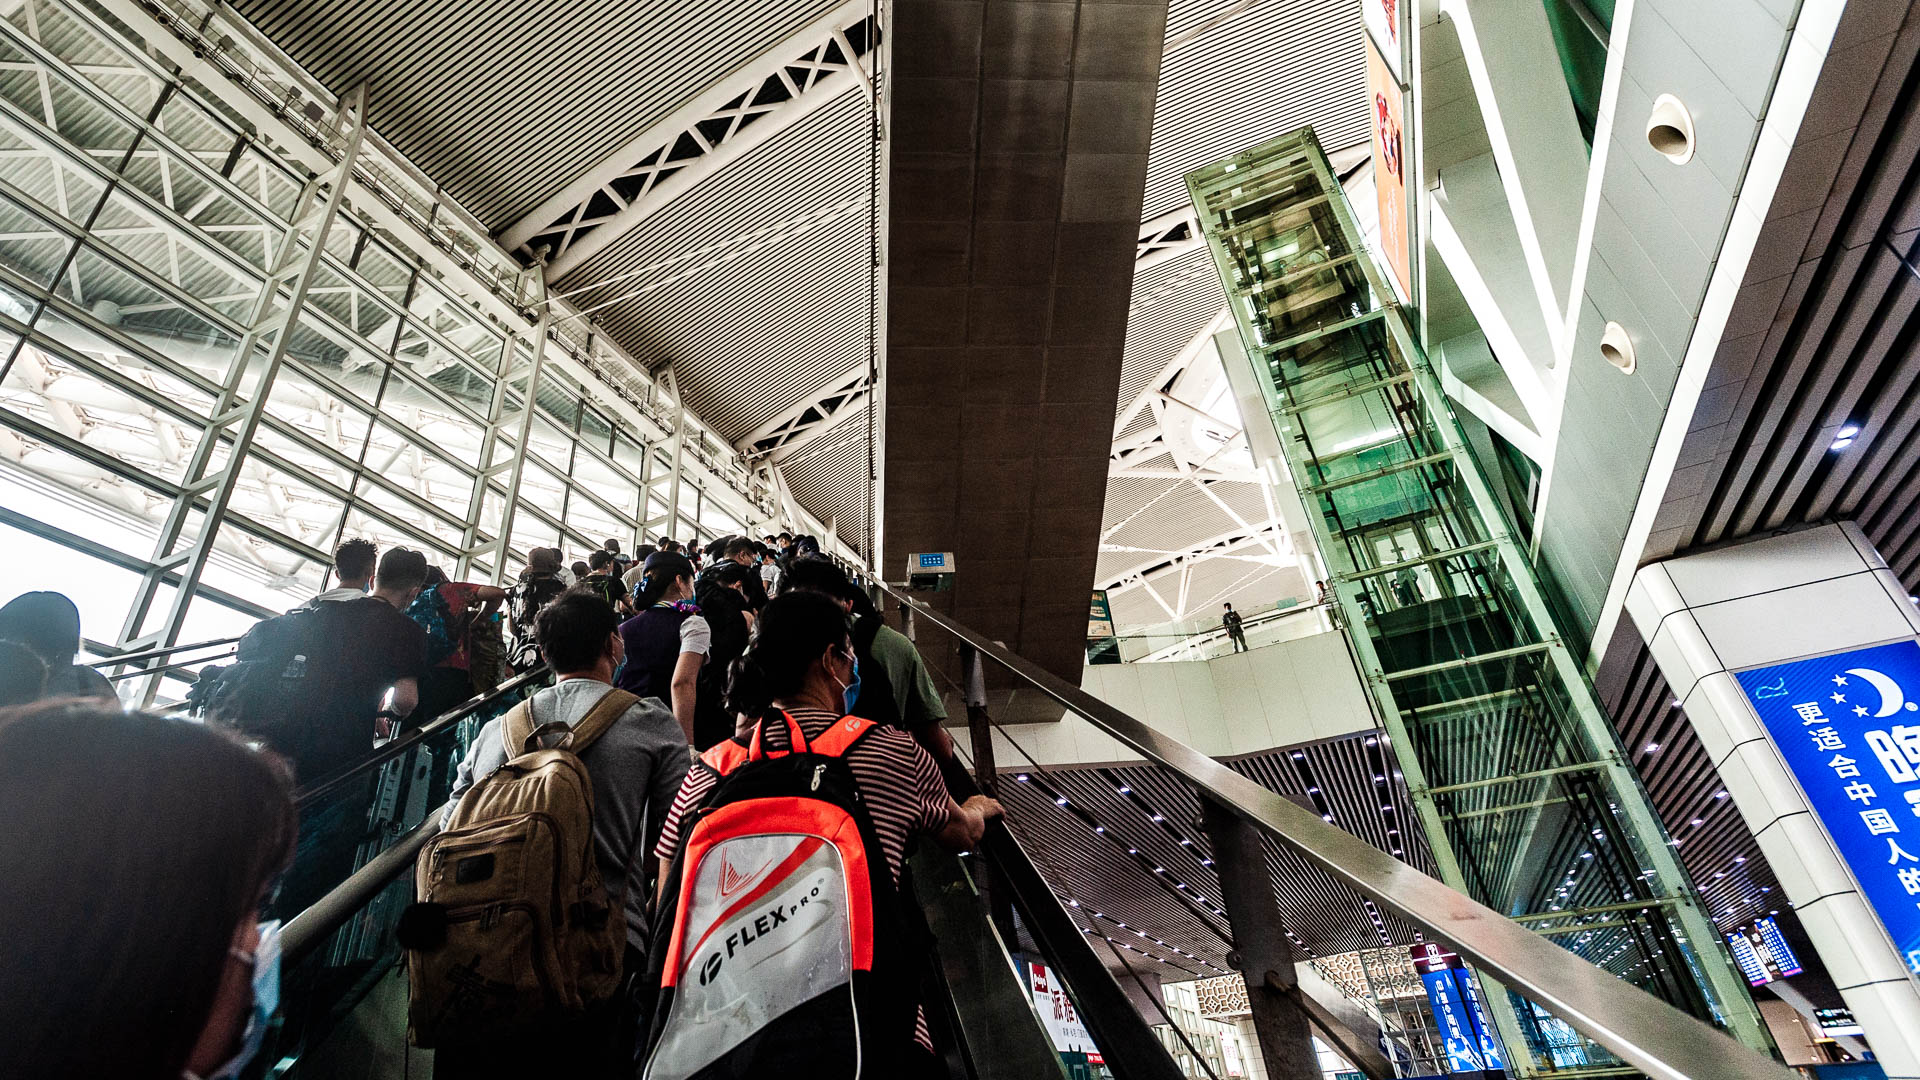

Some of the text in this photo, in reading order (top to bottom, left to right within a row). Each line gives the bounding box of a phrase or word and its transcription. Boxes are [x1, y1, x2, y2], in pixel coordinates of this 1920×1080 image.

[1864, 724, 1920, 819] 晚
[1792, 701, 1920, 918] 更适合中国人的
[725, 905, 788, 959] FLEX
[1050, 988, 1079, 1024] 派雅
